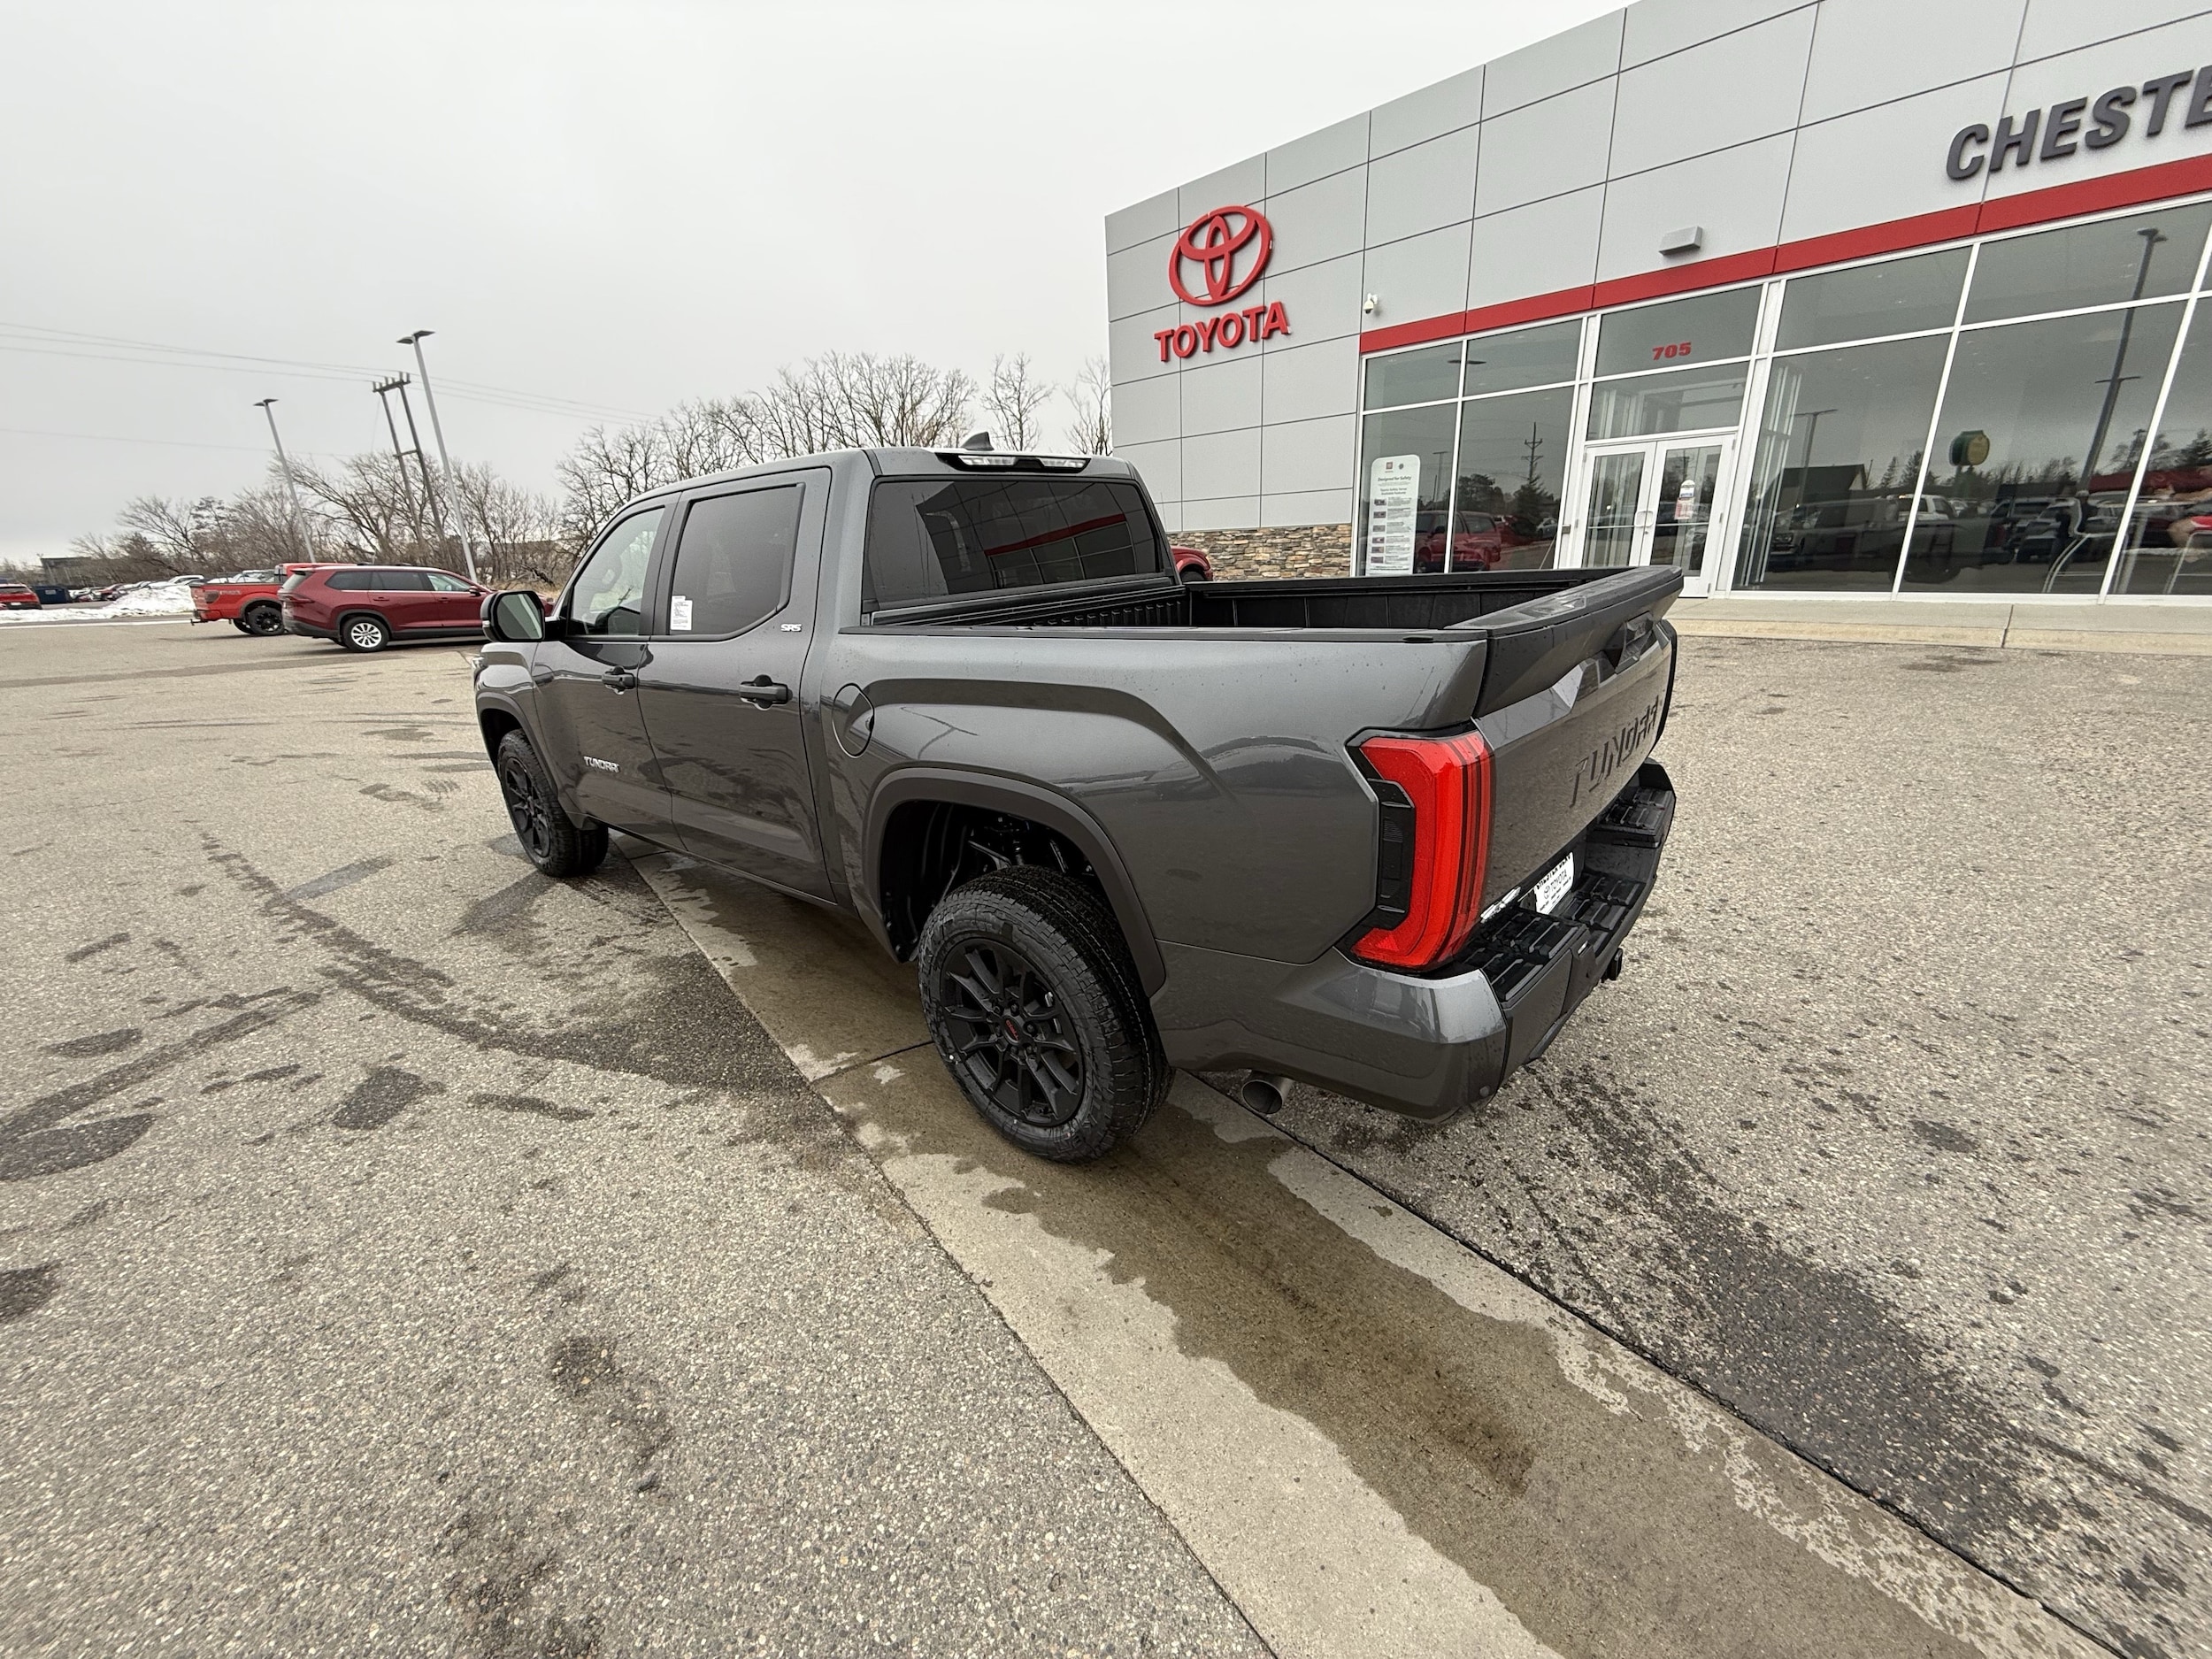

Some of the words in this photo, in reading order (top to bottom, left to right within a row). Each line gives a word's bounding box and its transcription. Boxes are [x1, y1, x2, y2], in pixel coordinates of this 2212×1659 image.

[1154, 301, 1292, 363] TOYOTA
[1652, 341, 1692, 361] 705
[780, 623, 803, 632] SR5
[1569, 695, 1660, 809] TUNDRA
[583, 756, 620, 773] TUNDRA
[1550, 869, 1567, 892] TOYOTA
